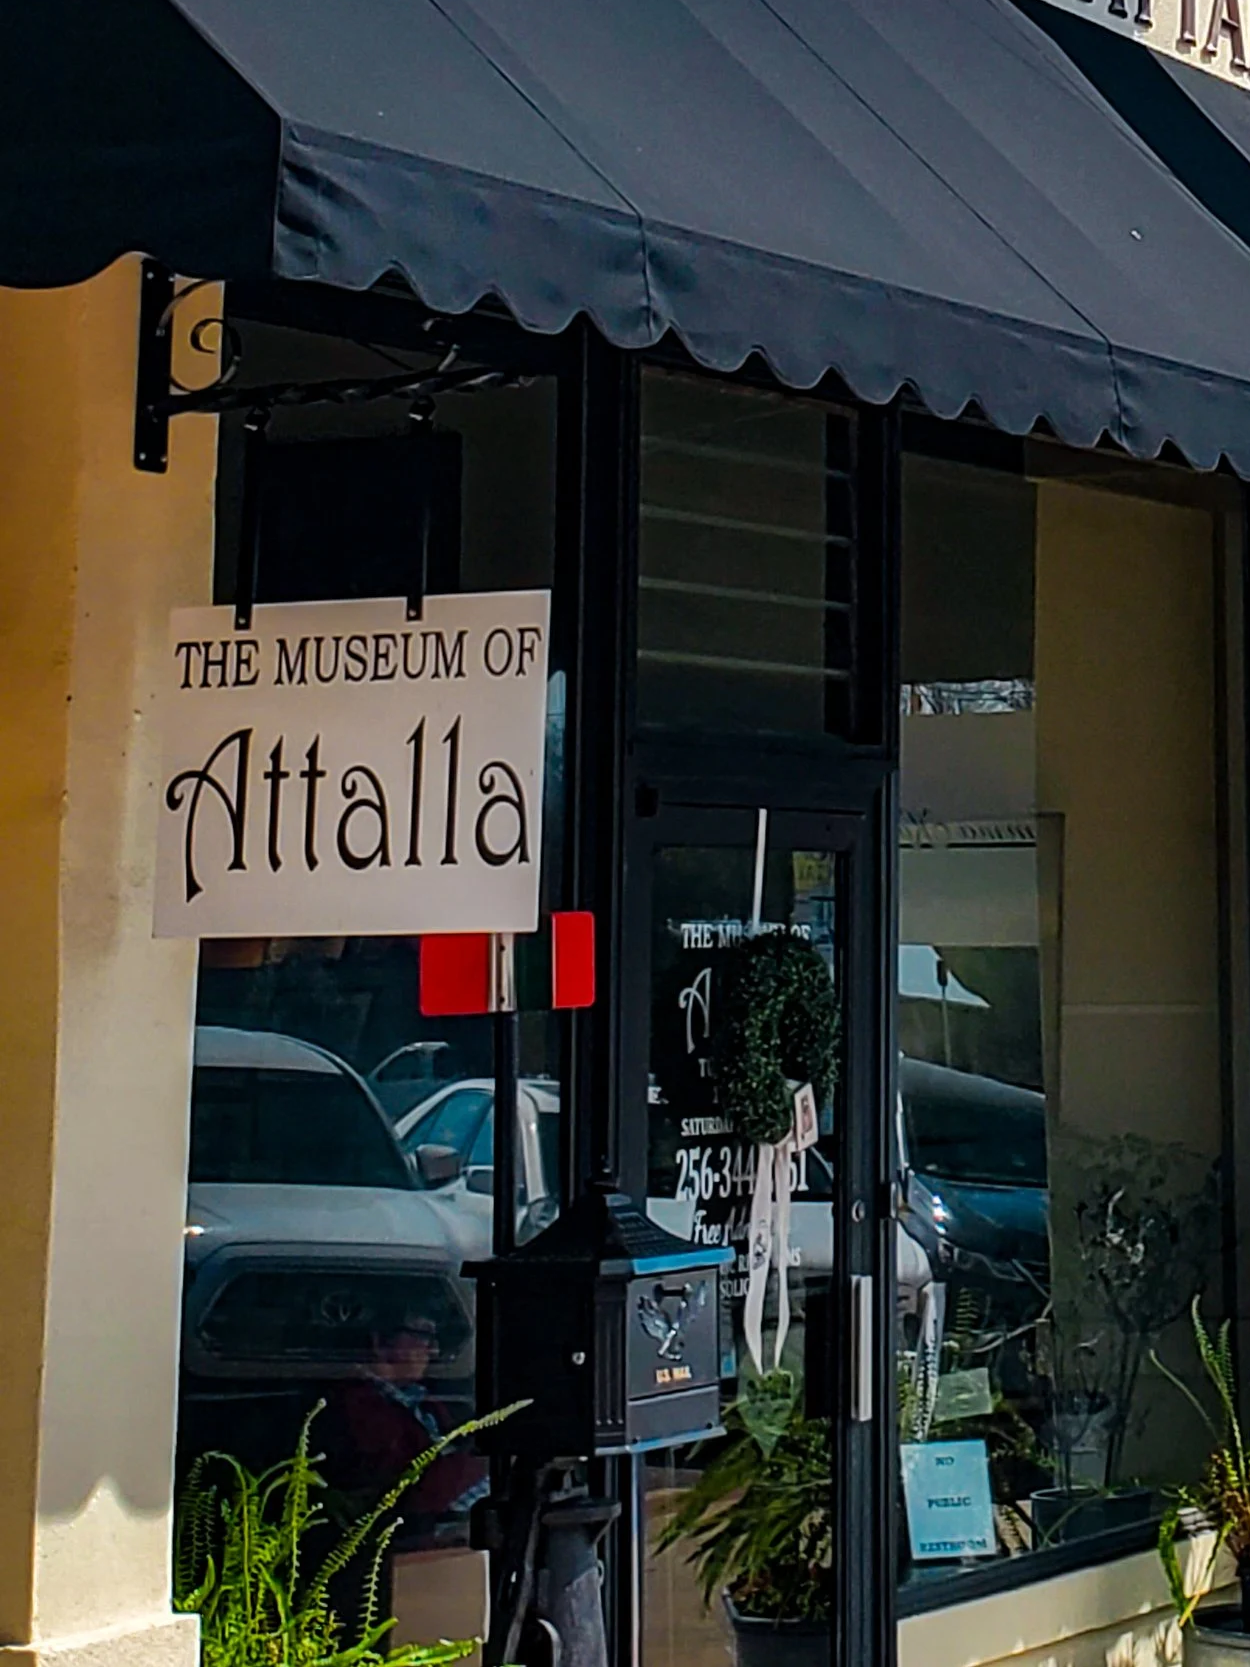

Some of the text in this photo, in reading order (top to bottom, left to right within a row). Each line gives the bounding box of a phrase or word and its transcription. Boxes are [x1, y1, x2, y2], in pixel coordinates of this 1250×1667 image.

[175, 627, 541, 689] THE MUSEUM OF
[166, 714, 530, 903] Attalla
[680, 922, 713, 949] THE
